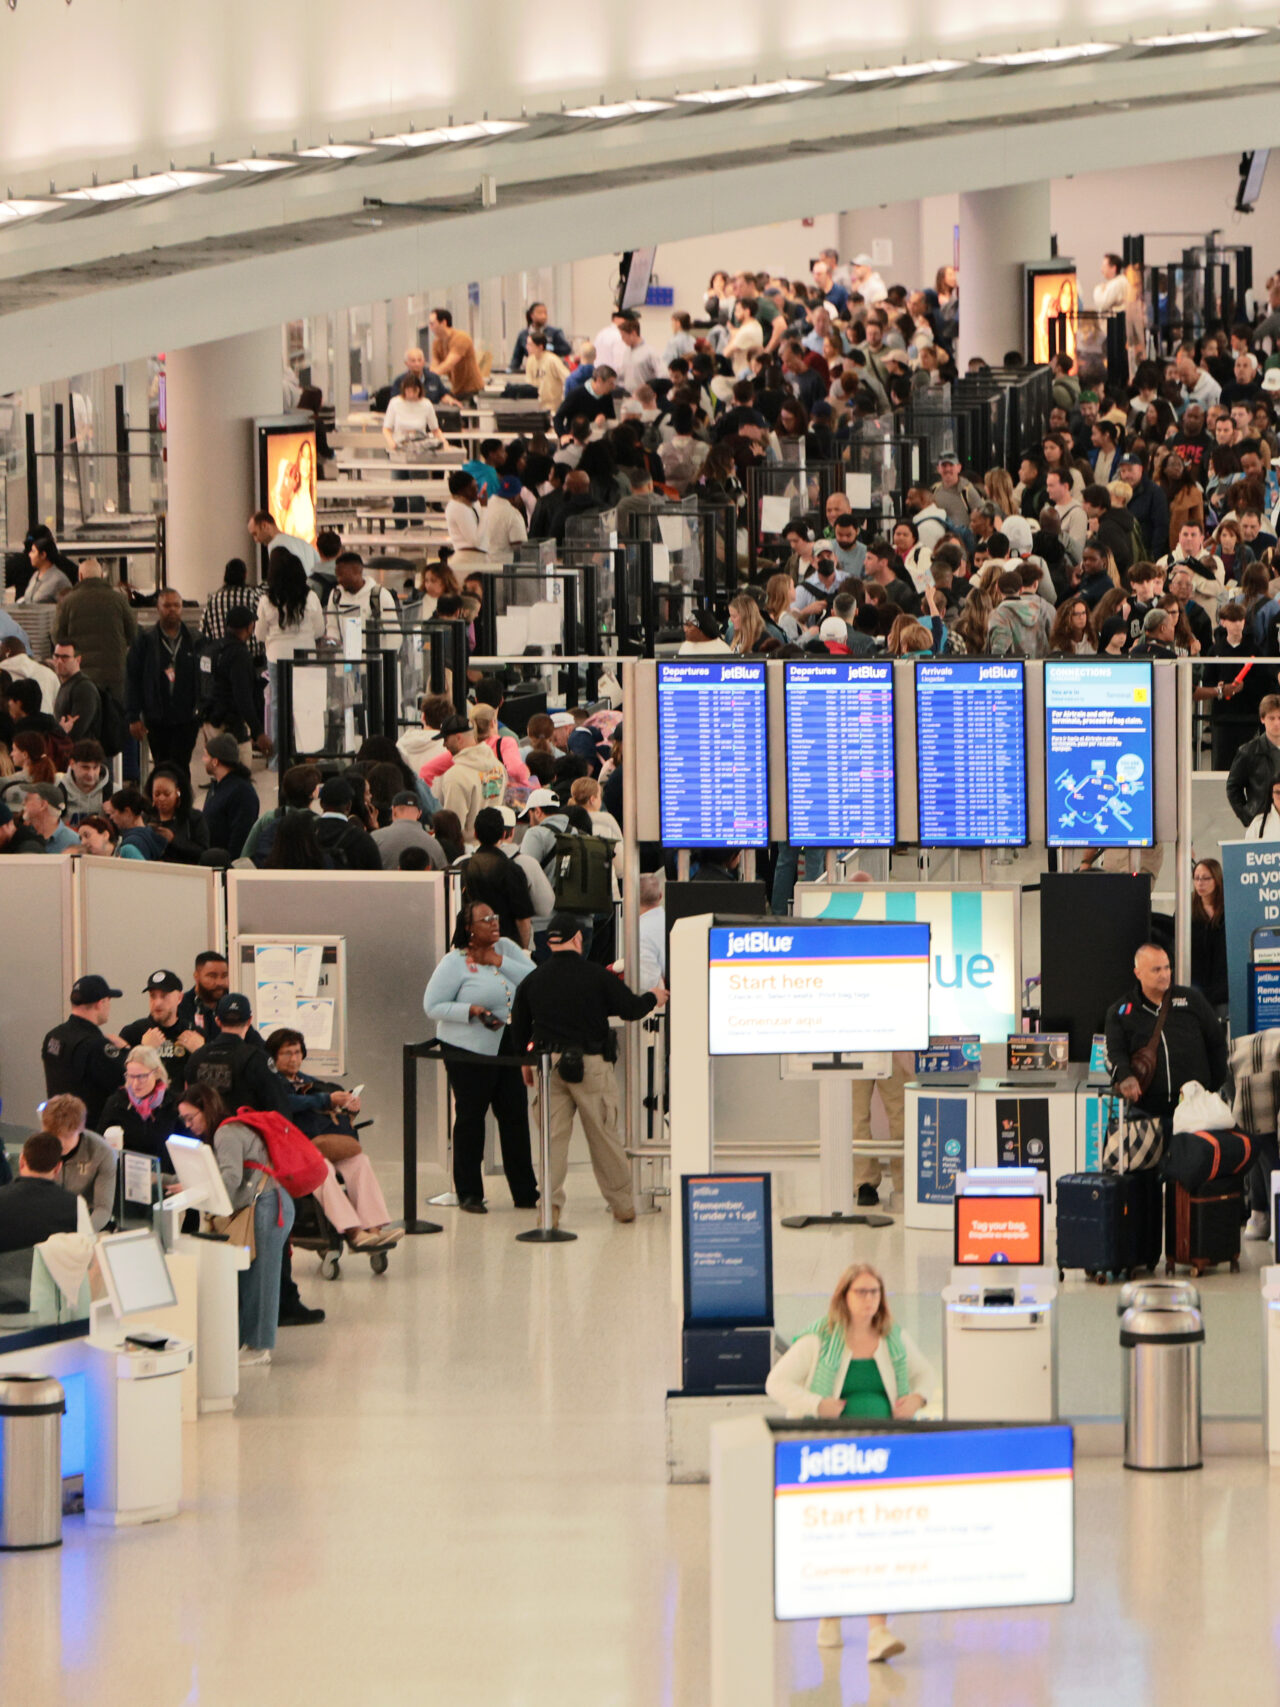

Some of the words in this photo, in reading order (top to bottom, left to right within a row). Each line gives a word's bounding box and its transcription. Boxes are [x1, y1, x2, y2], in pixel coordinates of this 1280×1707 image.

[662, 666, 710, 677] Departures
[720, 666, 761, 682] jetBlue
[790, 666, 837, 677] Departures
[848, 666, 888, 682] jetBlue
[920, 666, 953, 677] Arrivals
[978, 666, 1018, 681] jetBlue
[1240, 871, 1259, 885] on
[1264, 905, 1280, 920] ID
[726, 931, 794, 957] jetBlue
[728, 974, 777, 990] Start
[782, 973, 824, 989] here
[692, 1200, 745, 1211] Remember,
[699, 1211, 727, 1221] under
[741, 1210, 758, 1222] up!
[971, 1220, 988, 1233] Tag
[798, 1443, 890, 1483] jetBlue
[801, 1503, 868, 1529] Start
[874, 1500, 931, 1524] here
